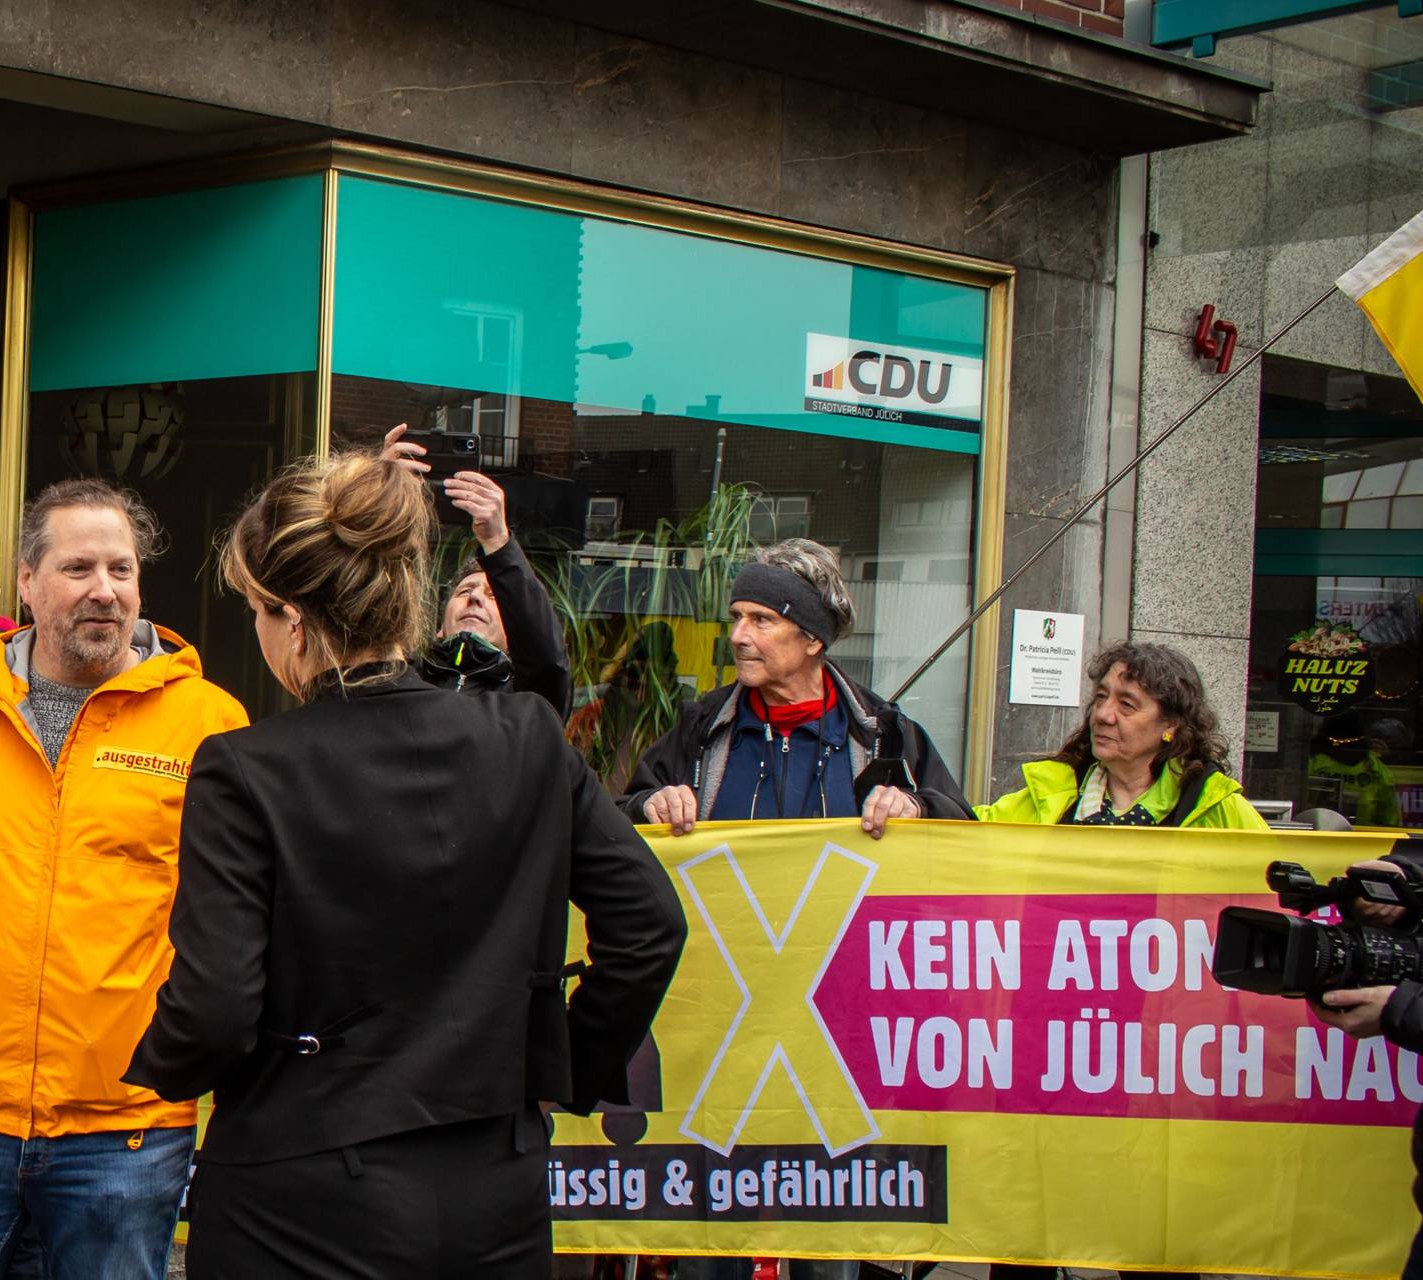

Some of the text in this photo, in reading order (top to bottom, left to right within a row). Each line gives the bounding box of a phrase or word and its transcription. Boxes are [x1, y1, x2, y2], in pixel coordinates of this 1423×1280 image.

[848, 350, 952, 404] CDU
[812, 401, 902, 422] STADTVERBAND JÜLICH
[1029, 645, 1049, 654] Patricia
[1050, 646, 1062, 656] Peill
[1062, 648, 1076, 656] (CDU)
[1285, 658, 1369, 676] HALUZ
[1292, 678, 1360, 694] NUTS
[868, 919, 1021, 991] KEIN
[869, 1016, 1013, 1090] VON
[1040, 1007, 1265, 1098] JÜLICH
[662, 1159, 694, 1206] &
[709, 1159, 925, 1212] gefährlich
